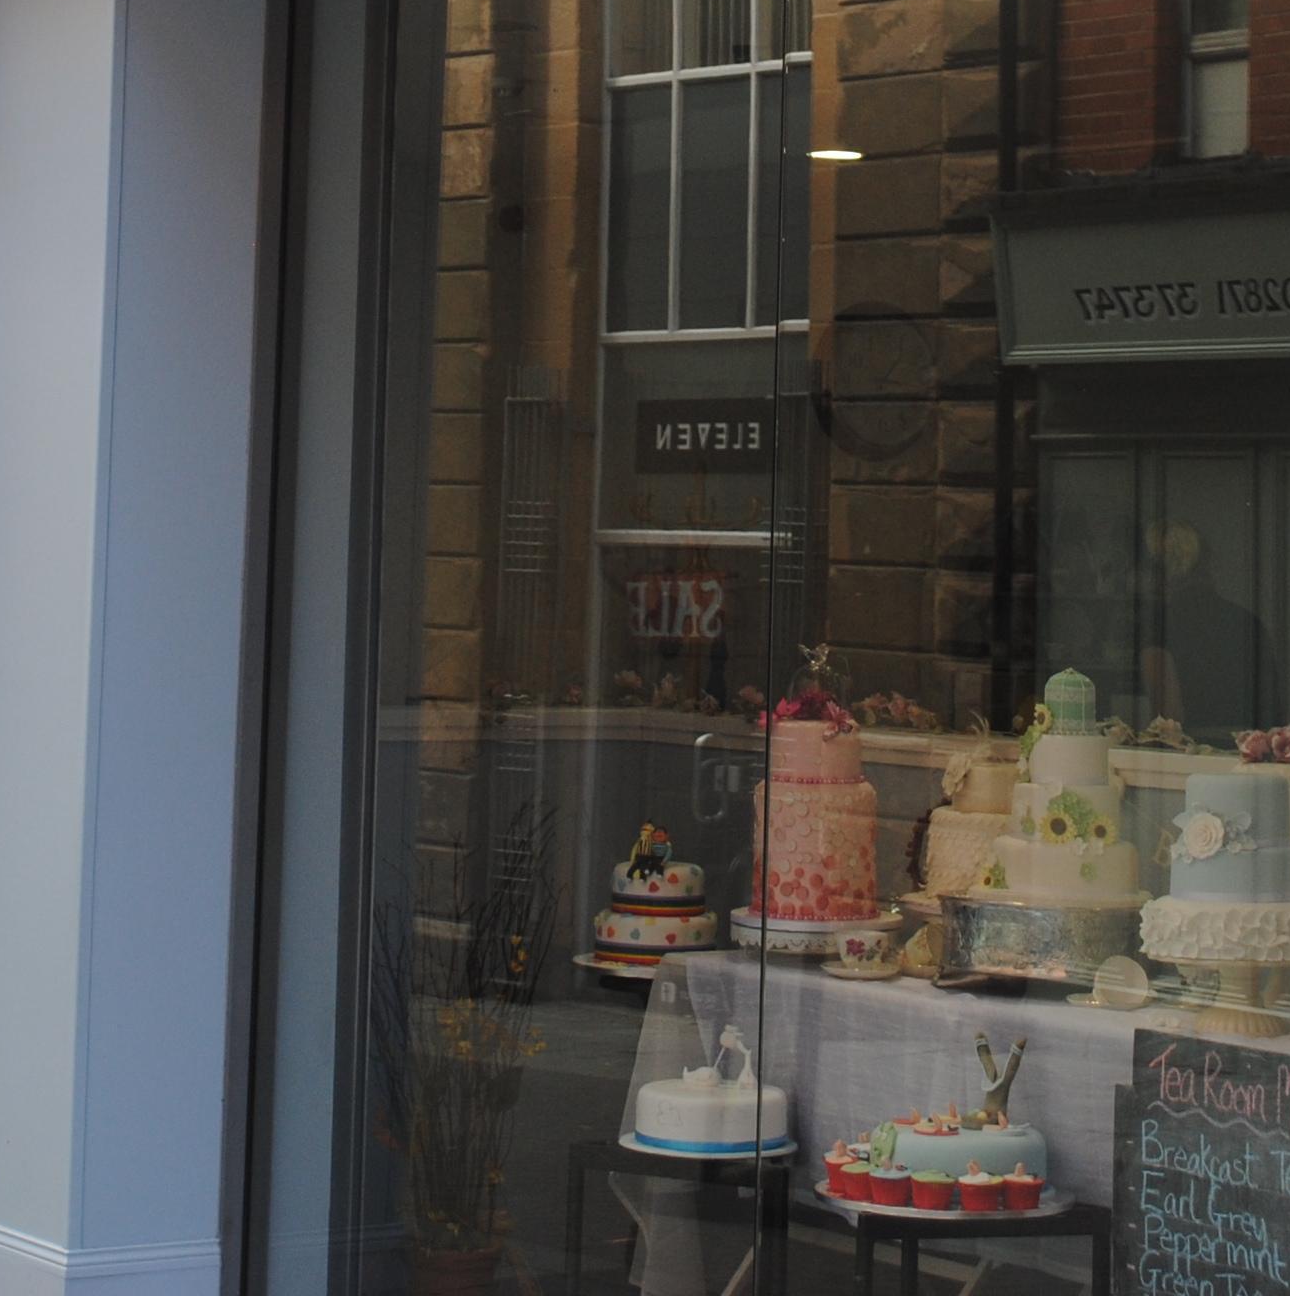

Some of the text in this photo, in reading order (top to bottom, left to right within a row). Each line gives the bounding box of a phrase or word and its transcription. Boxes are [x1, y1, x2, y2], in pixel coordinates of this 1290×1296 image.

[1149, 1043, 1196, 1104] Tea
[1203, 1051, 1267, 1123] Room
[1141, 1171, 1201, 1224] Earl
[1144, 1213, 1289, 1288] Peppermint
